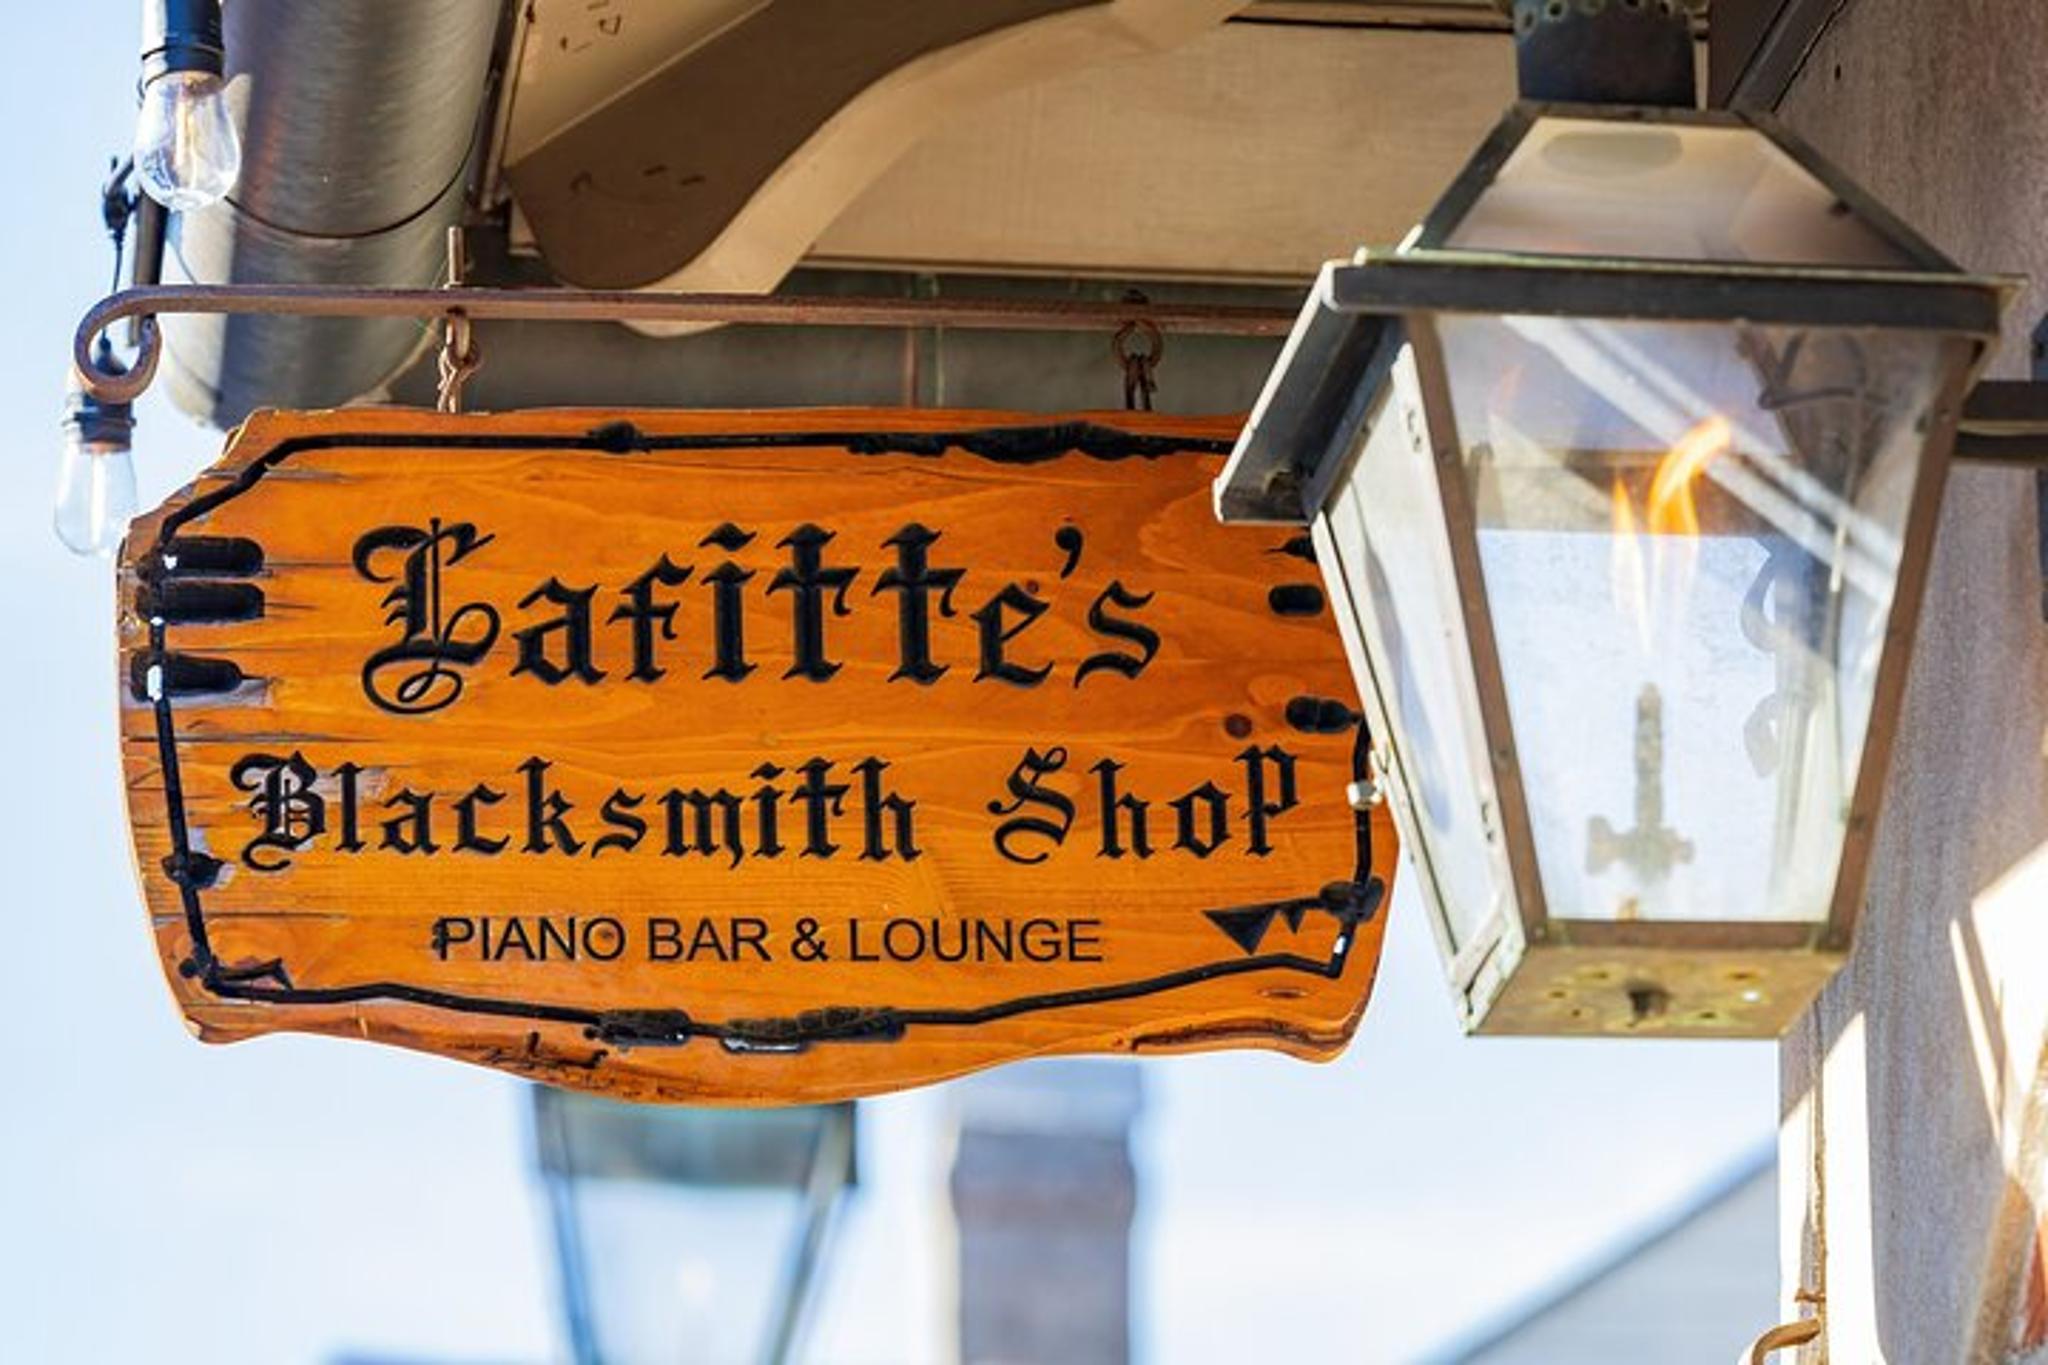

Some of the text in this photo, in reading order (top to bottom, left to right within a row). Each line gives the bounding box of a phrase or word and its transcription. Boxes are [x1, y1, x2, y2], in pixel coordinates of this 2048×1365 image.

[352, 517, 1162, 715] Lafitte's
[230, 742, 1302, 872] Blacksmith Shop
[437, 915, 1104, 964] PIANO BAR & LOUNGE
